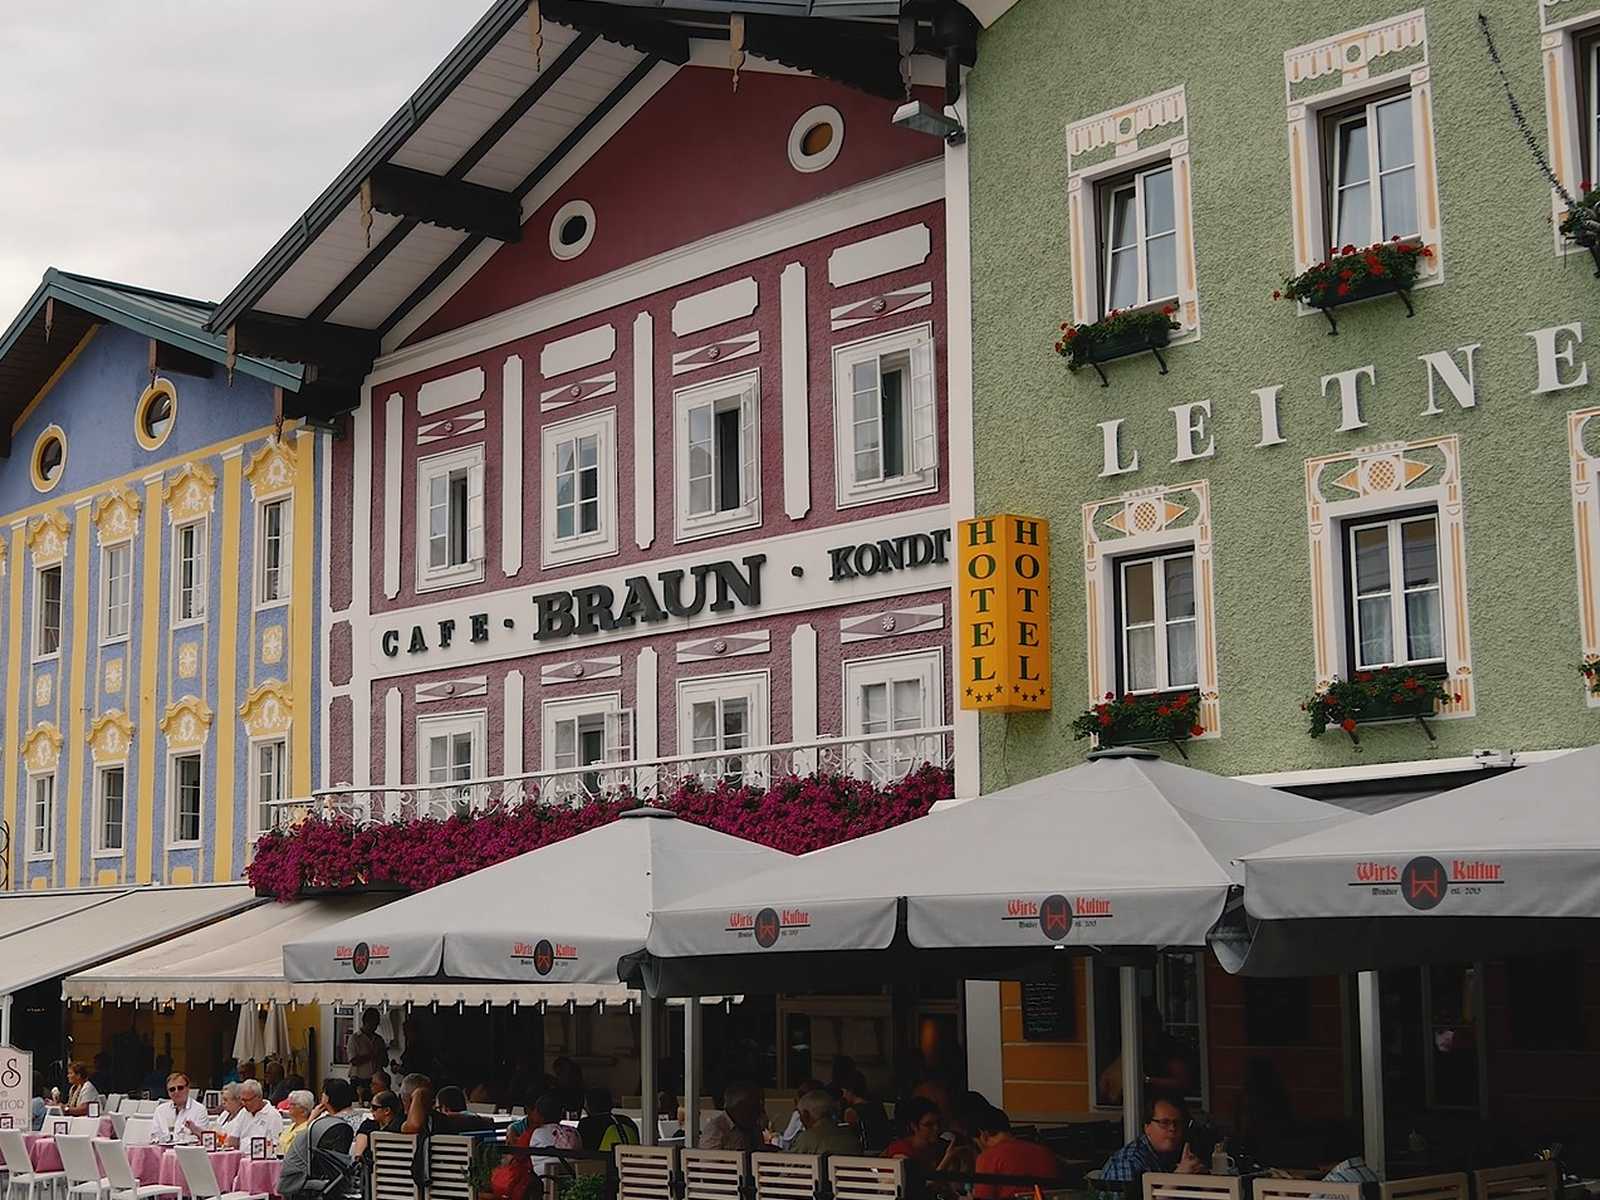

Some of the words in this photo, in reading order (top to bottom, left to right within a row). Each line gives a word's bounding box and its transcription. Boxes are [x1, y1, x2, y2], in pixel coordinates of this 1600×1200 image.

[1097, 321, 1590, 478] LEITNE
[382, 613, 489, 656] CAFE
[532, 554, 767, 642] BRAUN
[968, 519, 997, 681] HOTEL
[1013, 519, 1040, 681] HOTEL
[1357, 863, 1398, 881] Wirts
[1453, 861, 1501, 880] Kultur
